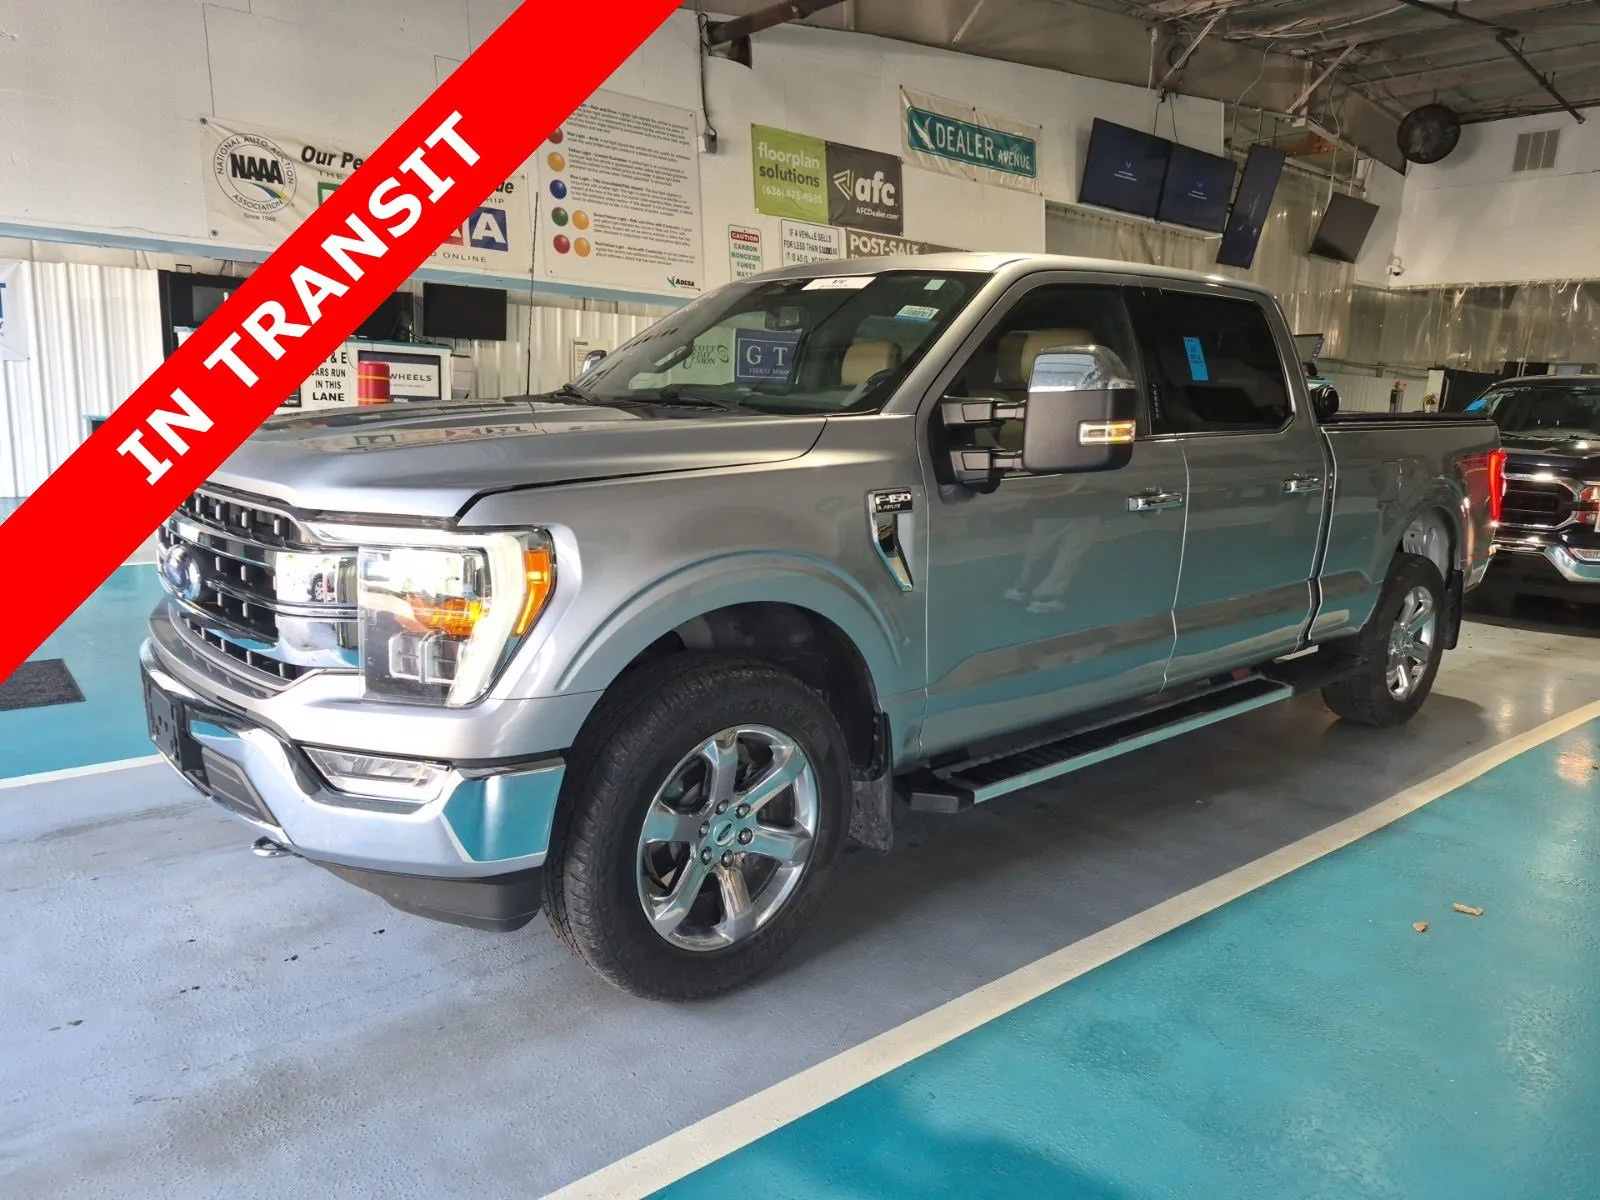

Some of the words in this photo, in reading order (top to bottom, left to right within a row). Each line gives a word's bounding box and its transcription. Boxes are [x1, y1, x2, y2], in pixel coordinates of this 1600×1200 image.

[936, 123, 994, 160] DEALER
[998, 149, 1031, 169] AVENUE
[216, 138, 241, 174] NATIONAL
[243, 136, 268, 148] AUTO
[270, 147, 293, 185] AUCTION
[301, 145, 336, 166] Our
[758, 142, 820, 169] floorplan
[230, 153, 284, 184] NAAA
[320, 171, 343, 180] THE
[759, 164, 820, 188] solutions
[762, 184, 785, 200] (636)
[855, 171, 896, 207] afc
[232, 194, 284, 210] ASSOCIATION
[856, 207, 899, 220] AFCDealer.com
[732, 232, 758, 242] CAUTION
[799, 230, 817, 241] VEHICLE
[818, 233, 832, 243] SELLS
[734, 243, 757, 252] CARBON
[784, 239, 793, 248] FOR
[794, 241, 805, 251] LESS
[806, 243, 819, 252] THAN
[850, 233, 919, 256] POST-SALE
[443, 252, 487, 263] ONLINE
[731, 251, 760, 262] MONOXIDE
[737, 261, 756, 270] FUMES
[341, 352, 347, 364] E
[331, 368, 346, 378] RUN
[389, 373, 432, 382] WHEELS
[315, 380, 323, 388] IN
[325, 380, 341, 389] THIS
[312, 392, 345, 402] LANE
[876, 493, 911, 504] F-150
